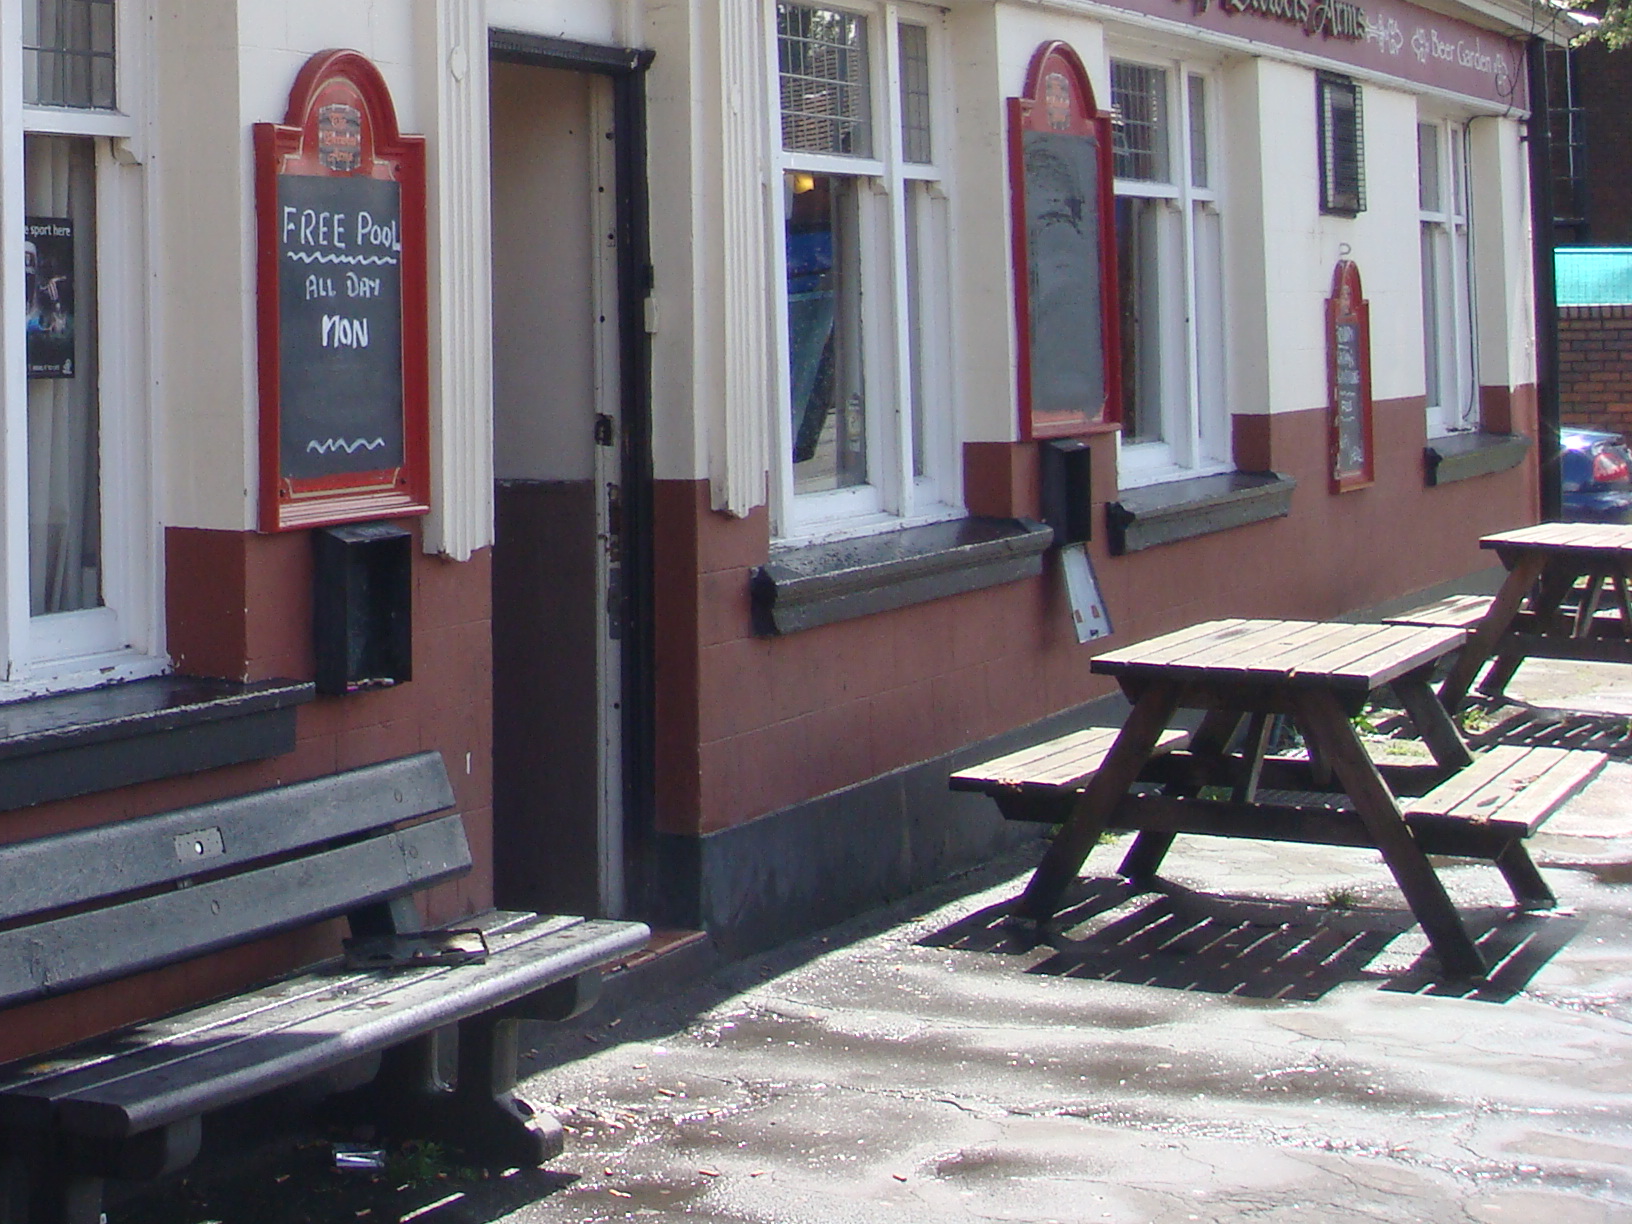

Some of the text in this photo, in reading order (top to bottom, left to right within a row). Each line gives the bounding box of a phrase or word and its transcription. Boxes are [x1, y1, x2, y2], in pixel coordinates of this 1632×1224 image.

[1431, 29, 1492, 73] Beer Garden
[53, 224, 70, 236] here
[283, 205, 345, 249] FREE
[305, 272, 380, 300] ALL DAY
[322, 314, 368, 349] MON
